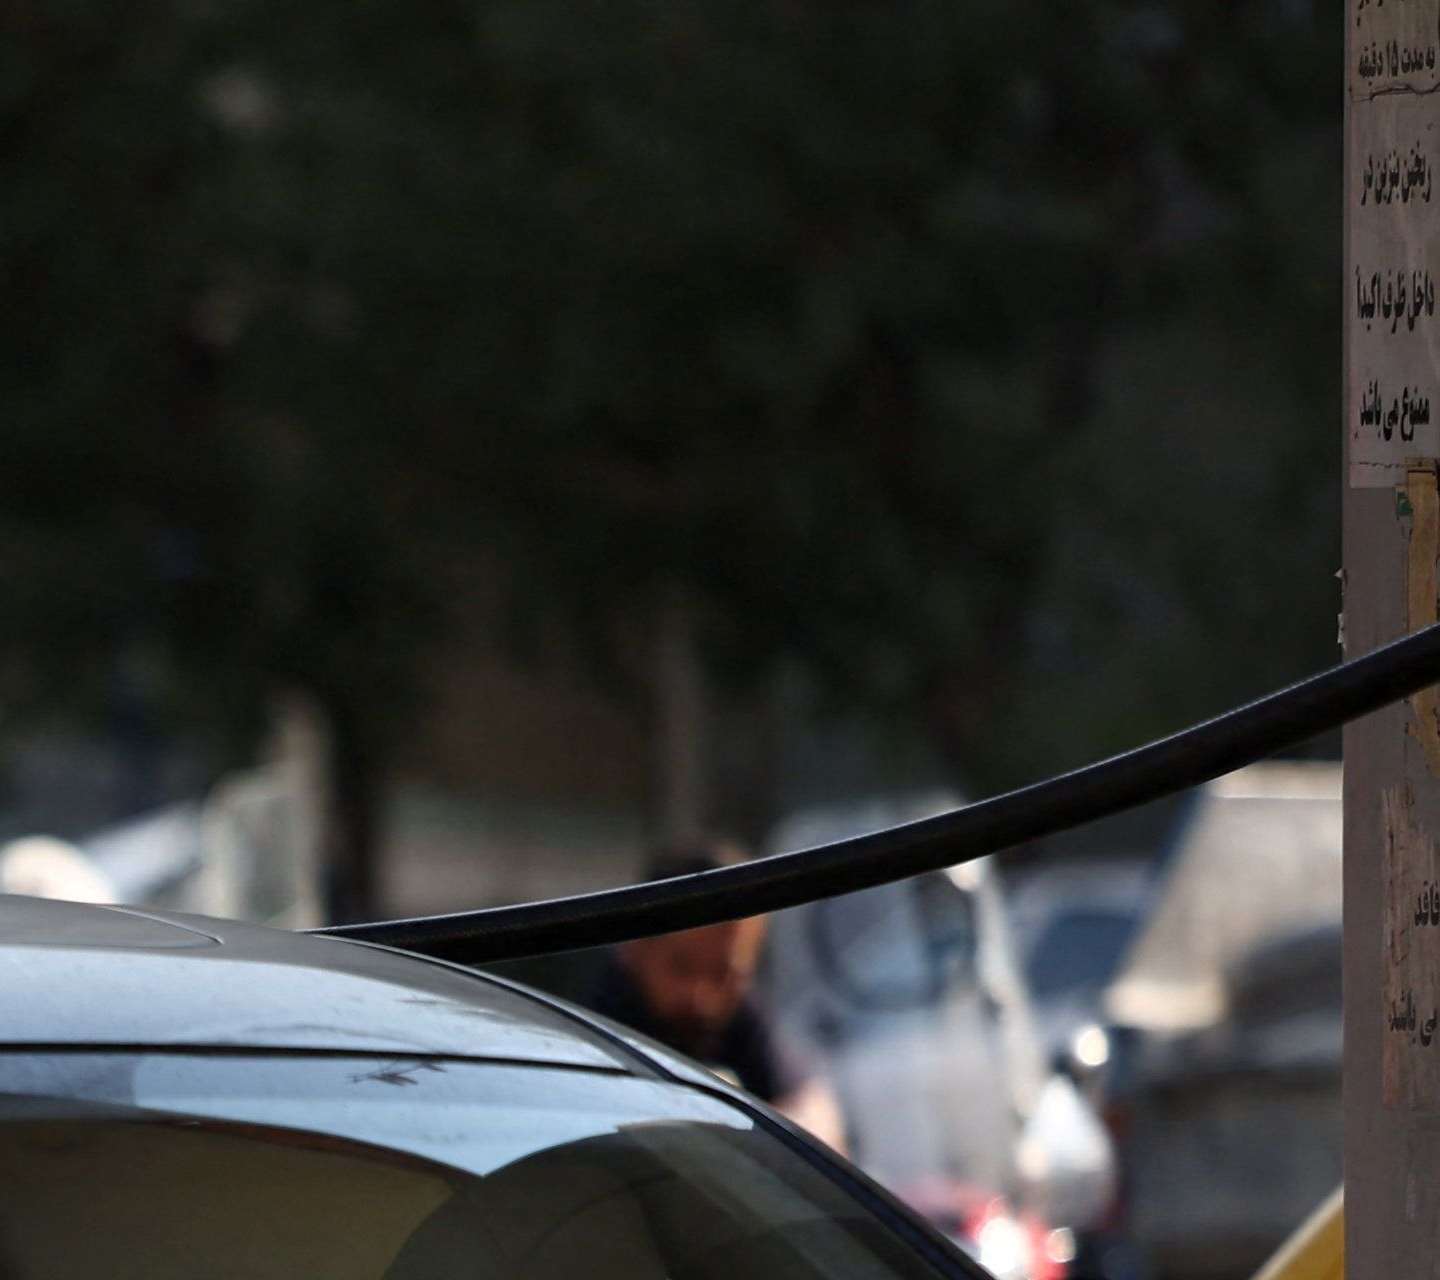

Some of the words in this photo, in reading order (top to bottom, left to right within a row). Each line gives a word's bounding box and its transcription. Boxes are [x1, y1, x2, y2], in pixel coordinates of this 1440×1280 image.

[1358, 41, 1383, 87] دقیقه
[1386, 39, 1399, 77] ۱۵
[1401, 47, 1424, 74] مدت
[1426, 46, 1436, 80] به
[1361, 153, 1374, 206] در
[1375, 149, 1400, 205] بنزین
[1401, 140, 1431, 203] ریختن
[1382, 269, 1406, 334] ظرف
[1407, 270, 1434, 331] داخل
[1383, 398, 1399, 442] می
[1401, 386, 1430, 442] ممنوع
[1414, 880, 1440, 927] فاقد
